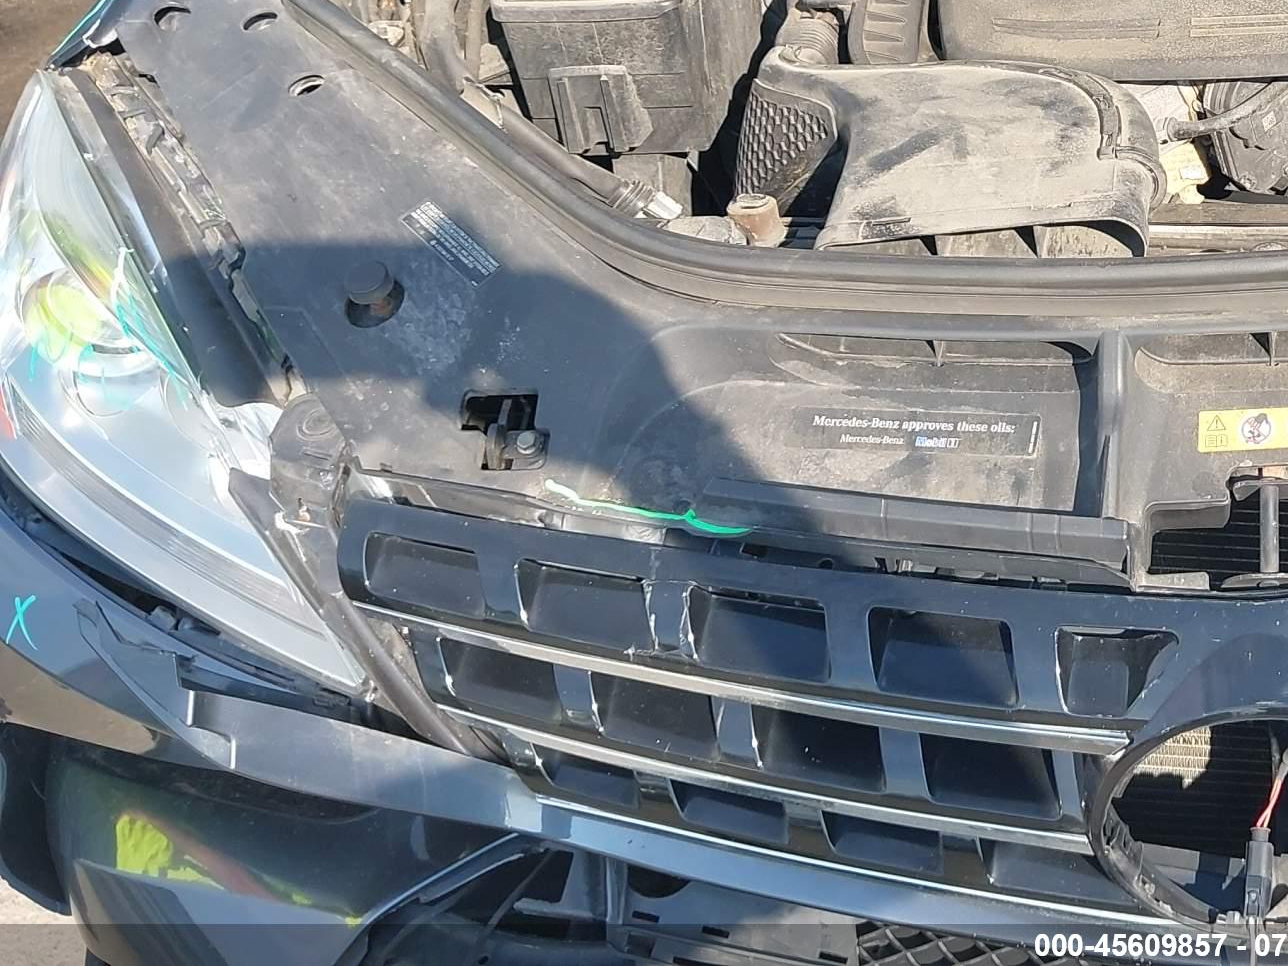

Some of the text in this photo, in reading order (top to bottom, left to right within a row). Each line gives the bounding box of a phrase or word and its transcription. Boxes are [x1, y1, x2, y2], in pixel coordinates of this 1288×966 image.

[812, 415, 1016, 433] Mercedes-Benz approves these oils:
[839, 434, 904, 445] Mercedes-Benz
